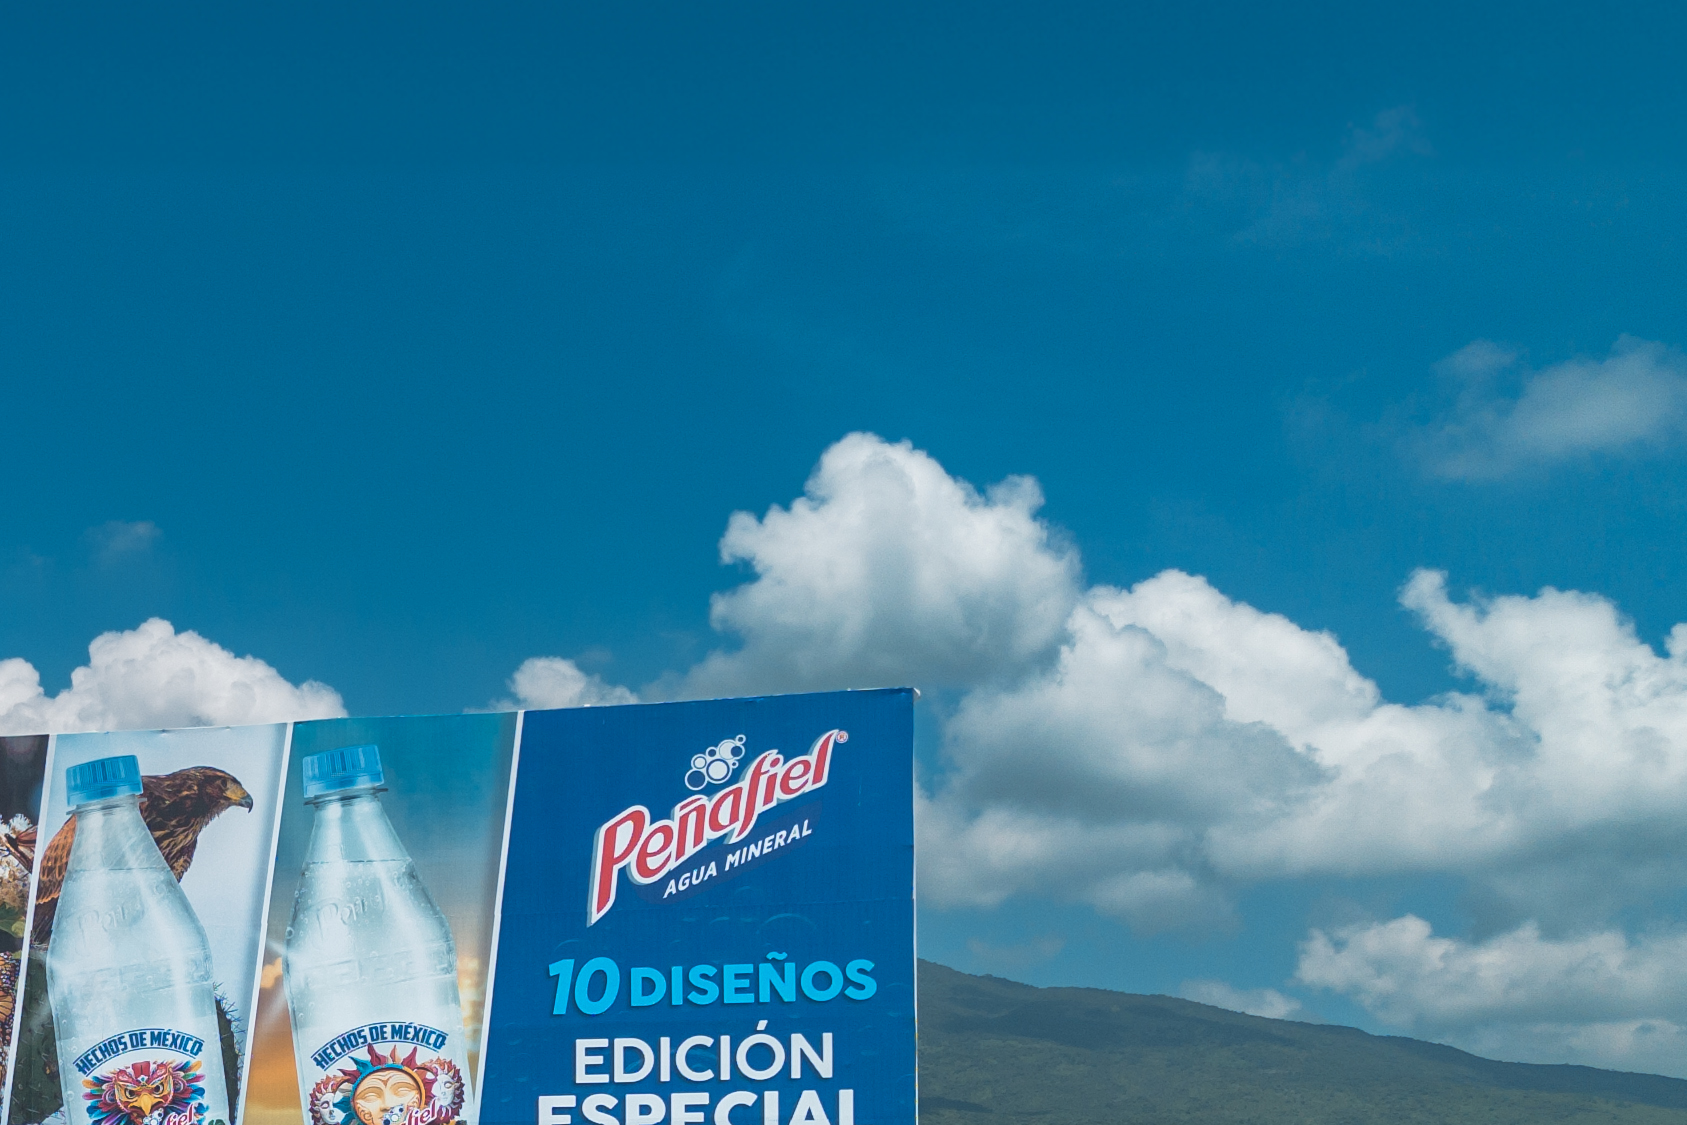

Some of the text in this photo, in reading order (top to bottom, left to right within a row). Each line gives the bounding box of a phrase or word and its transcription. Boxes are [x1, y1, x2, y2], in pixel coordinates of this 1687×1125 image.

[587, 729, 840, 927] Peñafiel
[663, 819, 813, 899] AGUA MINERAL
[548, 952, 878, 1015] 10 DISEÑOS
[75, 1029, 204, 1076] HECHOS DE MÉXICO
[313, 1022, 448, 1069] HECHOS DE MÉXICO
[575, 1020, 833, 1084] EDICIÓN
